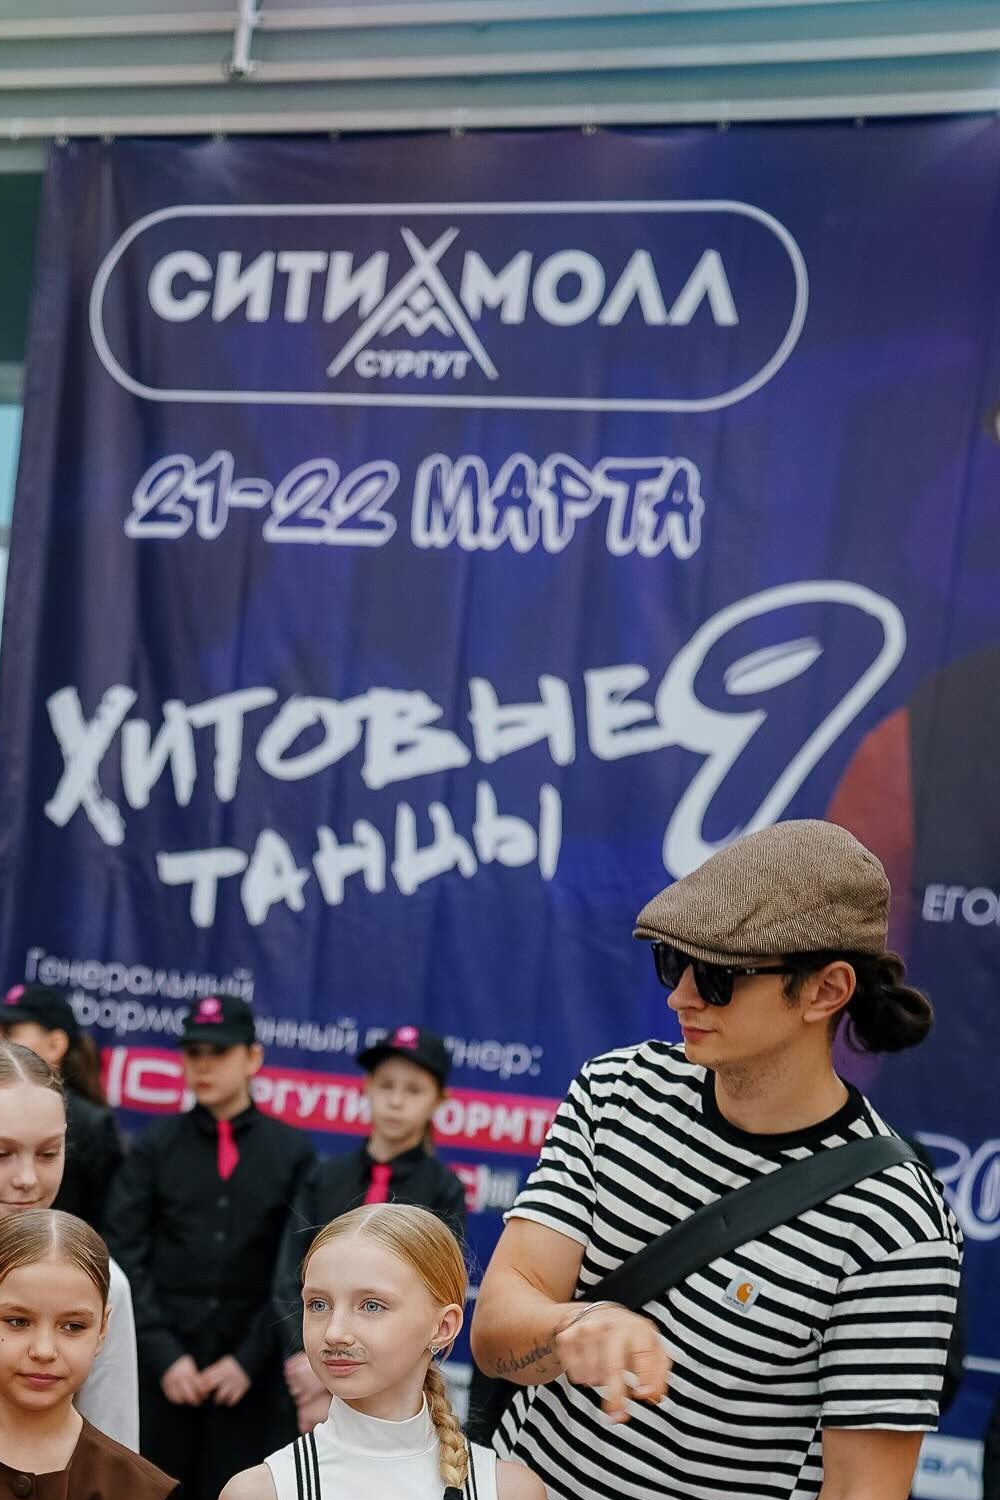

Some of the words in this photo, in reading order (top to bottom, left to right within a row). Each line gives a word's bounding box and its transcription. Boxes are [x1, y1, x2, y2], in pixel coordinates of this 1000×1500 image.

[354, 349, 473, 379] СУРГУТ
[124, 449, 400, 546] 21-22
[411, 453, 705, 560] МАРТА
[44, 664, 662, 846] ХИТОВЫЕ
[157, 780, 562, 928] ТАНЦЫ
[922, 883, 1000, 926] ЕГО
[25, 947, 255, 1002] Генеральный
